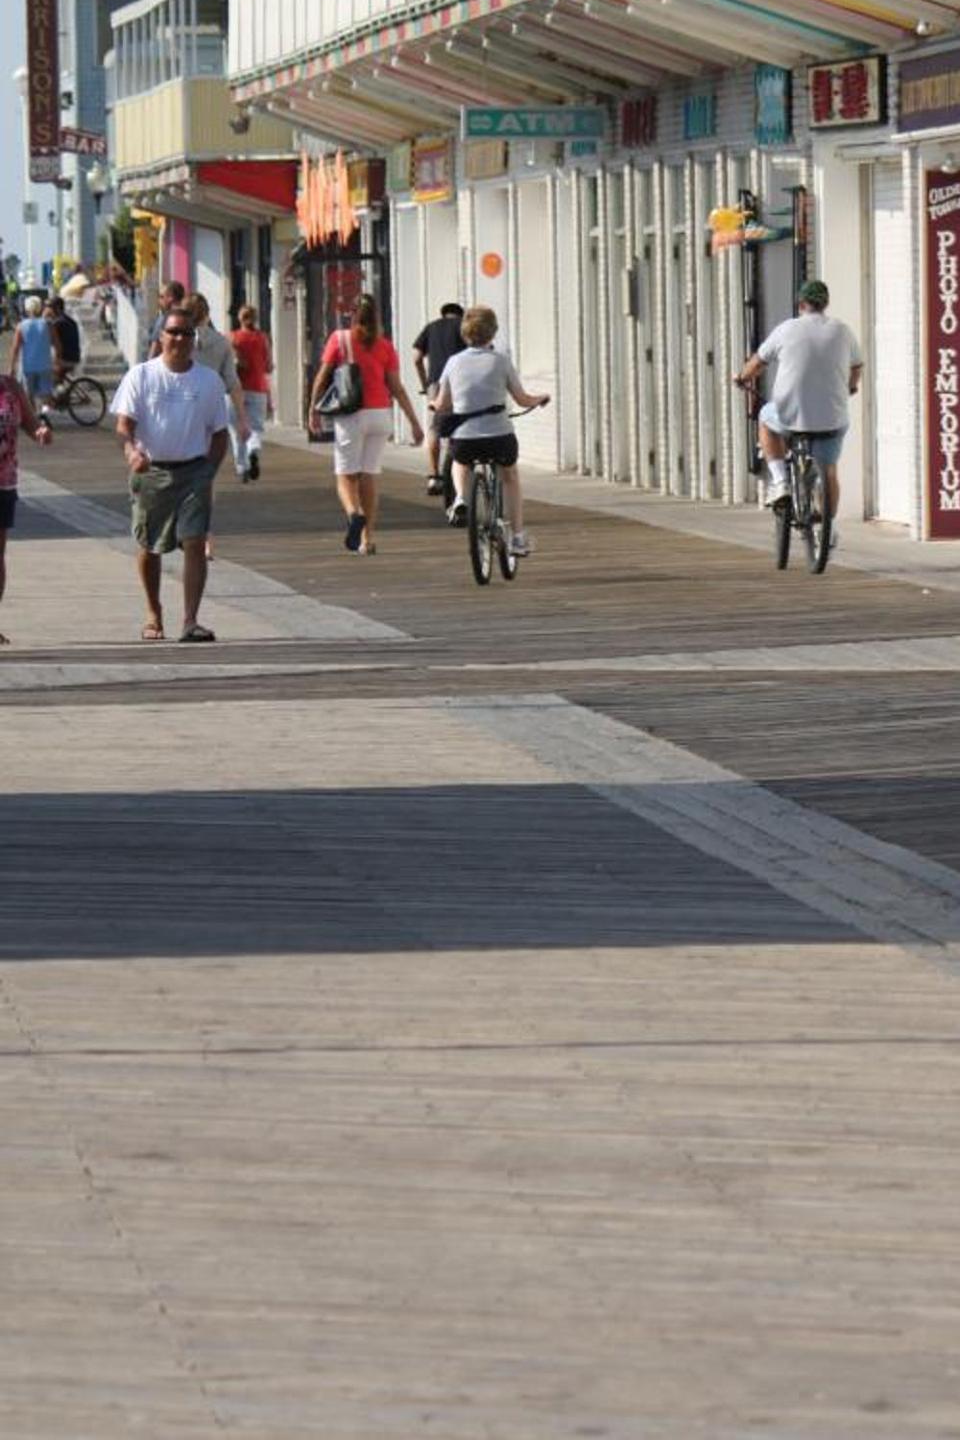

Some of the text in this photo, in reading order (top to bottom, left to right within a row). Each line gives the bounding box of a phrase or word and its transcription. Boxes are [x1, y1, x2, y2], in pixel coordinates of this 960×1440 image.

[499, 113, 575, 133] ATM
[64, 133, 106, 154] BAR
[937, 231, 958, 334] PHOTO
